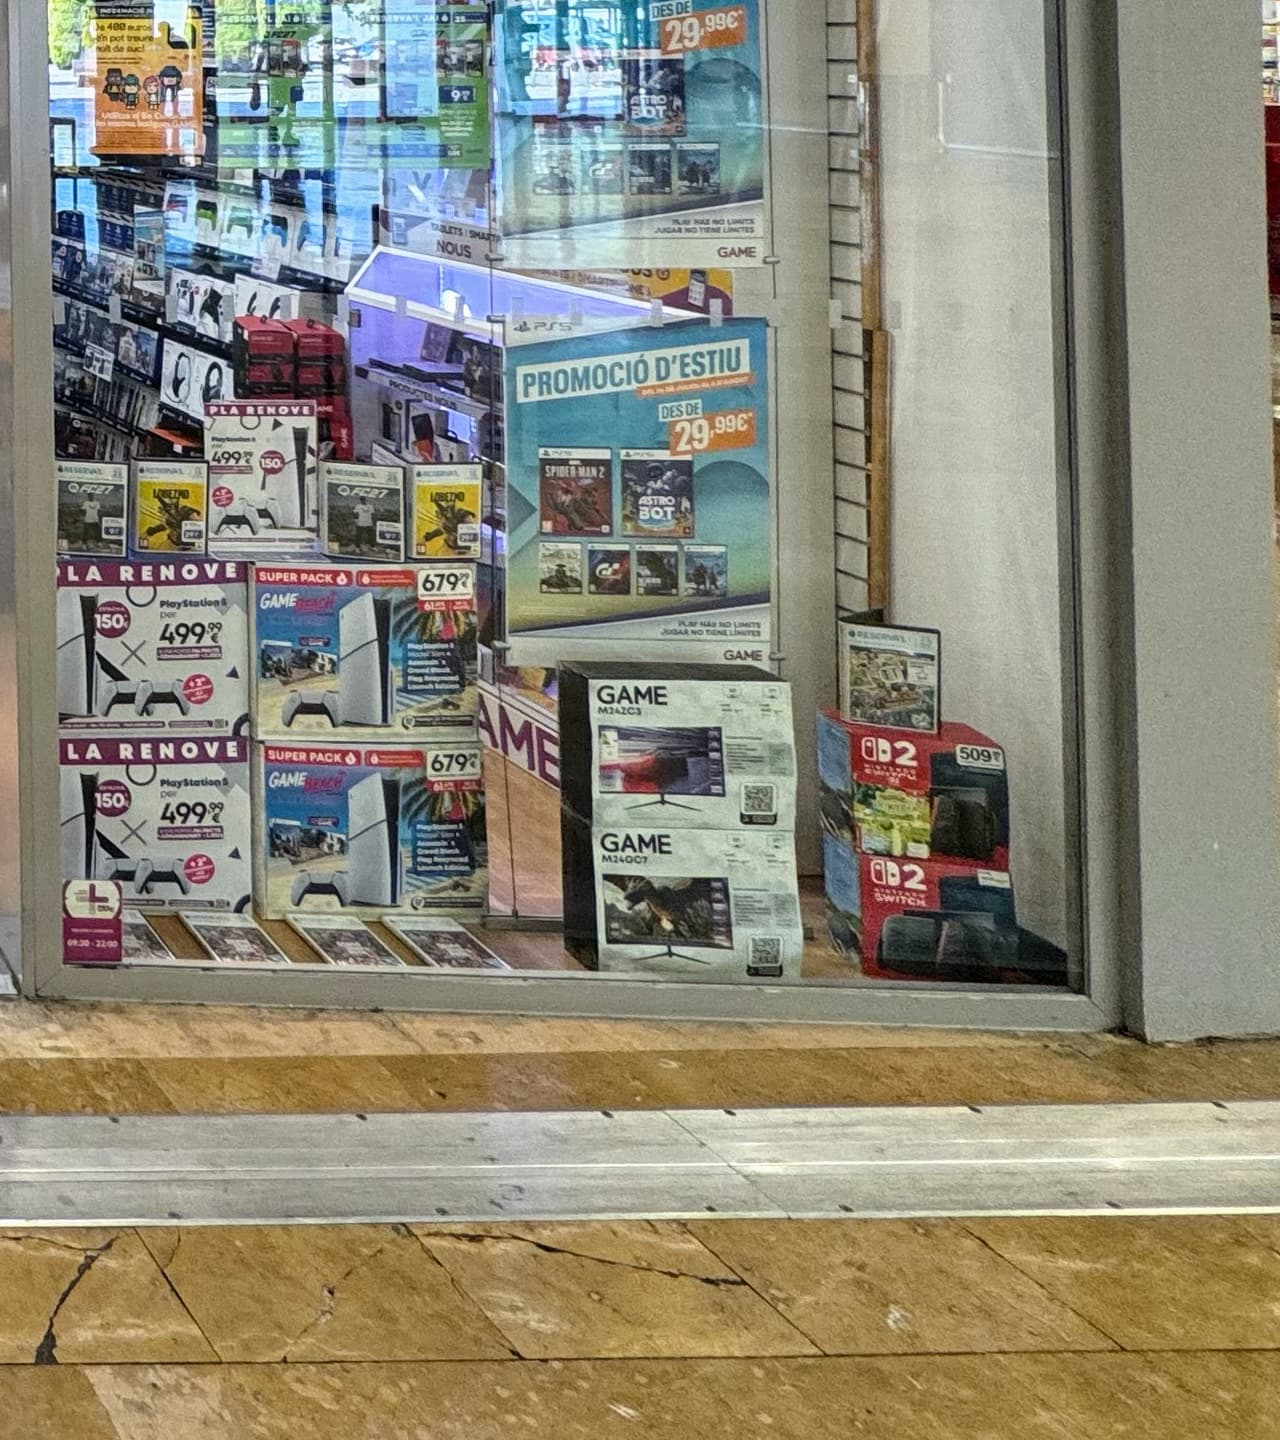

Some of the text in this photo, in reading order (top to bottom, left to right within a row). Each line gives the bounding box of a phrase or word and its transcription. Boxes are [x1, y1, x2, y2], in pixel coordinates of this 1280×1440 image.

[651, 0, 691, 19] DES DE
[113, 45, 124, 53] de
[437, 239, 472, 259] NOUS
[717, 246, 757, 258] GAME
[533, 322, 573, 331] PS5
[522, 355, 649, 398] PROMOCIÓ
[655, 346, 741, 381] D'ESTIU
[389, 380, 433, 402] PRODUCTES
[209, 404, 312, 416] PLA RENOVE
[661, 401, 700, 419] DES DE
[545, 465, 606, 479] SPIDER-MAN 2
[78, 484, 115, 495] FC27
[350, 486, 389, 499] FC27
[638, 495, 676, 506] ASTRO
[638, 506, 676, 521] BOT
[120, 562, 237, 582] RENOVE
[258, 571, 333, 583] SUPER PACK
[159, 598, 221, 610] PlayStation
[260, 592, 299, 609] GAME
[159, 612, 177, 620] per
[723, 649, 763, 662] GAME
[597, 685, 668, 706] GAME
[67, 741, 239, 760] LA RENOVE
[267, 750, 342, 763] SUPER PACK
[894, 740, 918, 767] 2
[159, 777, 221, 788] PlayStation
[268, 771, 308, 788] GAME
[159, 790, 178, 799] per
[600, 832, 673, 855] GAME
[903, 862, 927, 891] 2
